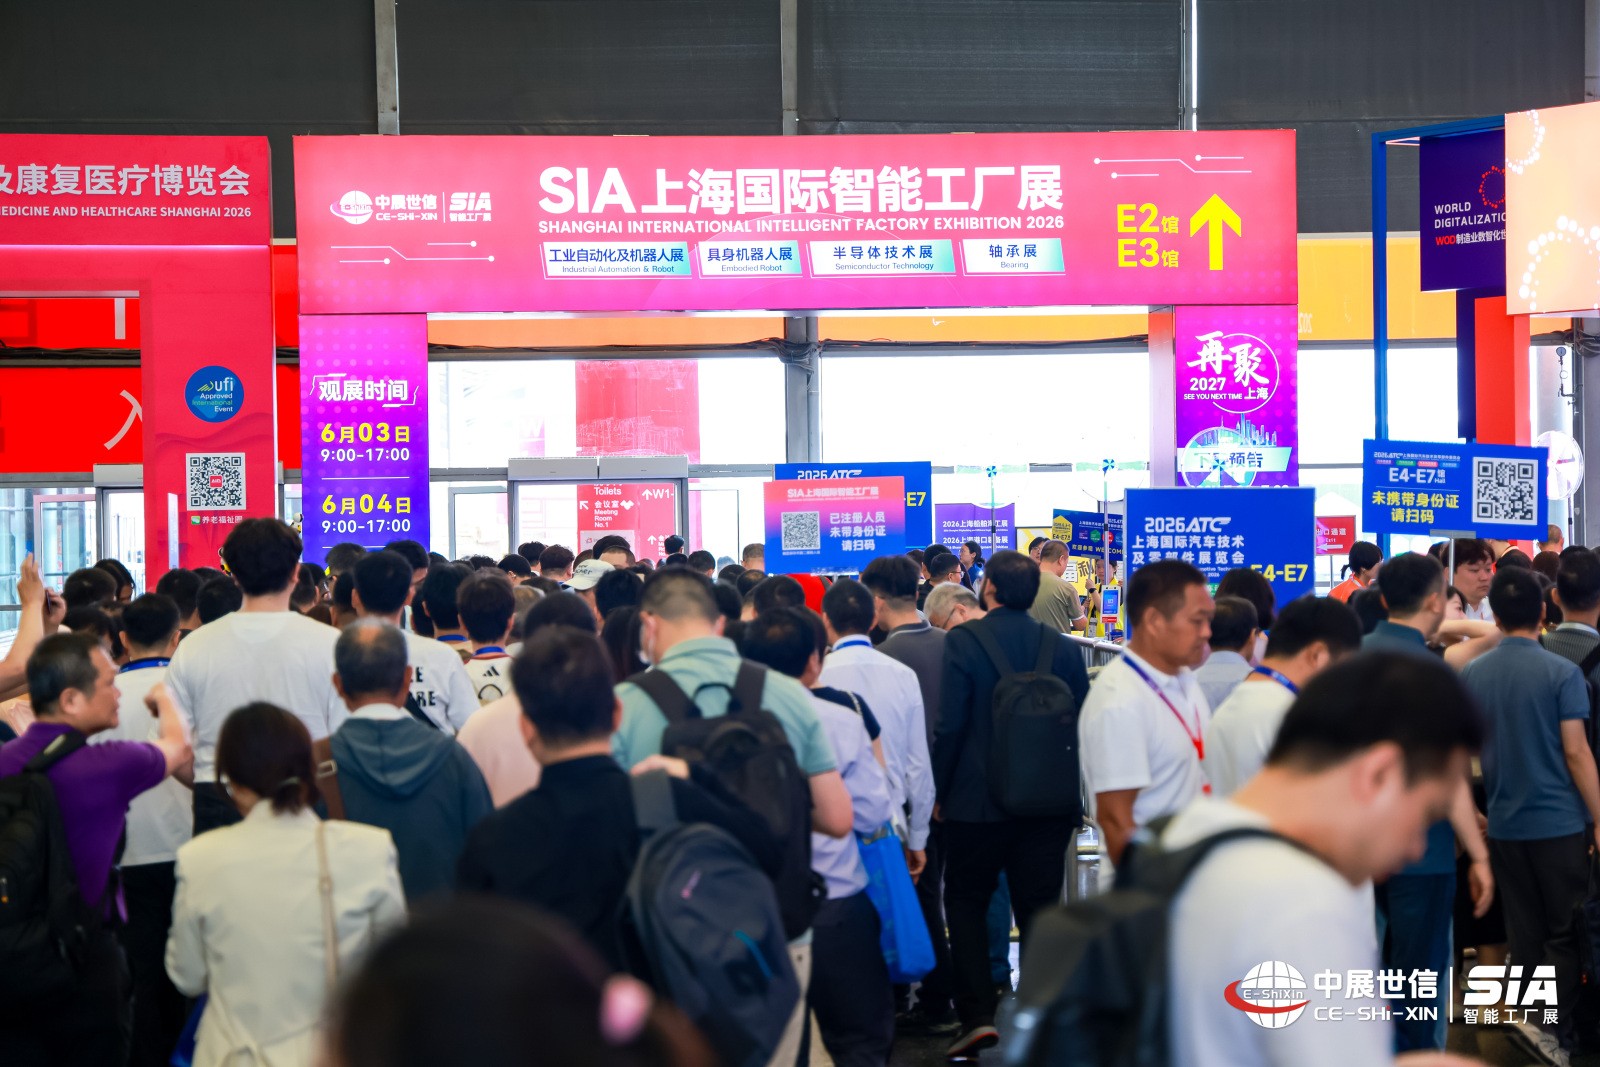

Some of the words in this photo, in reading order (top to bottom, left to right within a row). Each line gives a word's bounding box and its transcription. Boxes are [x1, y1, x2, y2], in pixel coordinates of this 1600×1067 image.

[375, 194, 437, 210] 中展世信
[1434, 202, 1472, 215] WORLD
[0, 205, 50, 217] EDICINE
[52, 206, 78, 217] AND
[81, 206, 157, 217] HEALTHCARE
[160, 206, 221, 217] SHANGHAI
[223, 206, 252, 217] 2026
[538, 220, 623, 234] SHANGHAI
[627, 219, 752, 234] INTERNATIONAL
[756, 218, 852, 232] INTELLIGENT
[856, 217, 929, 231] FACTORY
[933, 216, 1022, 230] EXHIBITION
[1026, 215, 1065, 229] 2026
[549, 248, 684, 263] 工业自动化及机器人展
[707, 247, 793, 262] 具身机器人展
[833, 245, 933, 259] 半导体技术展
[988, 244, 1037, 258] 轴承展
[562, 265, 596, 273] Industrial
[597, 265, 641, 273] Automation
[643, 265, 649, 273] &
[652, 265, 675, 273] Robot
[721, 264, 759, 272] Embodied
[759, 264, 782, 272] Robot
[835, 262, 890, 270] Semiconductor
[892, 262, 934, 271] Technology
[1000, 261, 1029, 270] Bearing
[1186, 330, 1270, 387] 再聚
[214, 377, 234, 392] ufi
[318, 379, 408, 401] 观展时间
[1189, 377, 1226, 391] 2027
[200, 392, 233, 400] Approved
[1244, 386, 1269, 400] 上海
[321, 422, 410, 443] 6月03日
[320, 447, 410, 462] 9:00-17:00
[1389, 467, 1436, 484] E4-E7
[594, 487, 622, 496] Toilets
[322, 493, 411, 515] 6月04日
[594, 500, 619, 509] 会议室
[1371, 490, 1460, 509] 未携带身份证
[594, 509, 618, 517] Meeting
[830, 511, 886, 525] 已注册人员
[1391, 507, 1435, 524] 请扫码
[321, 518, 411, 533] 9:00-17:00
[829, 525, 887, 538] 未带身份证
[841, 539, 876, 551] 请扫码
[1131, 535, 1245, 549] 上海国际汽车技术
